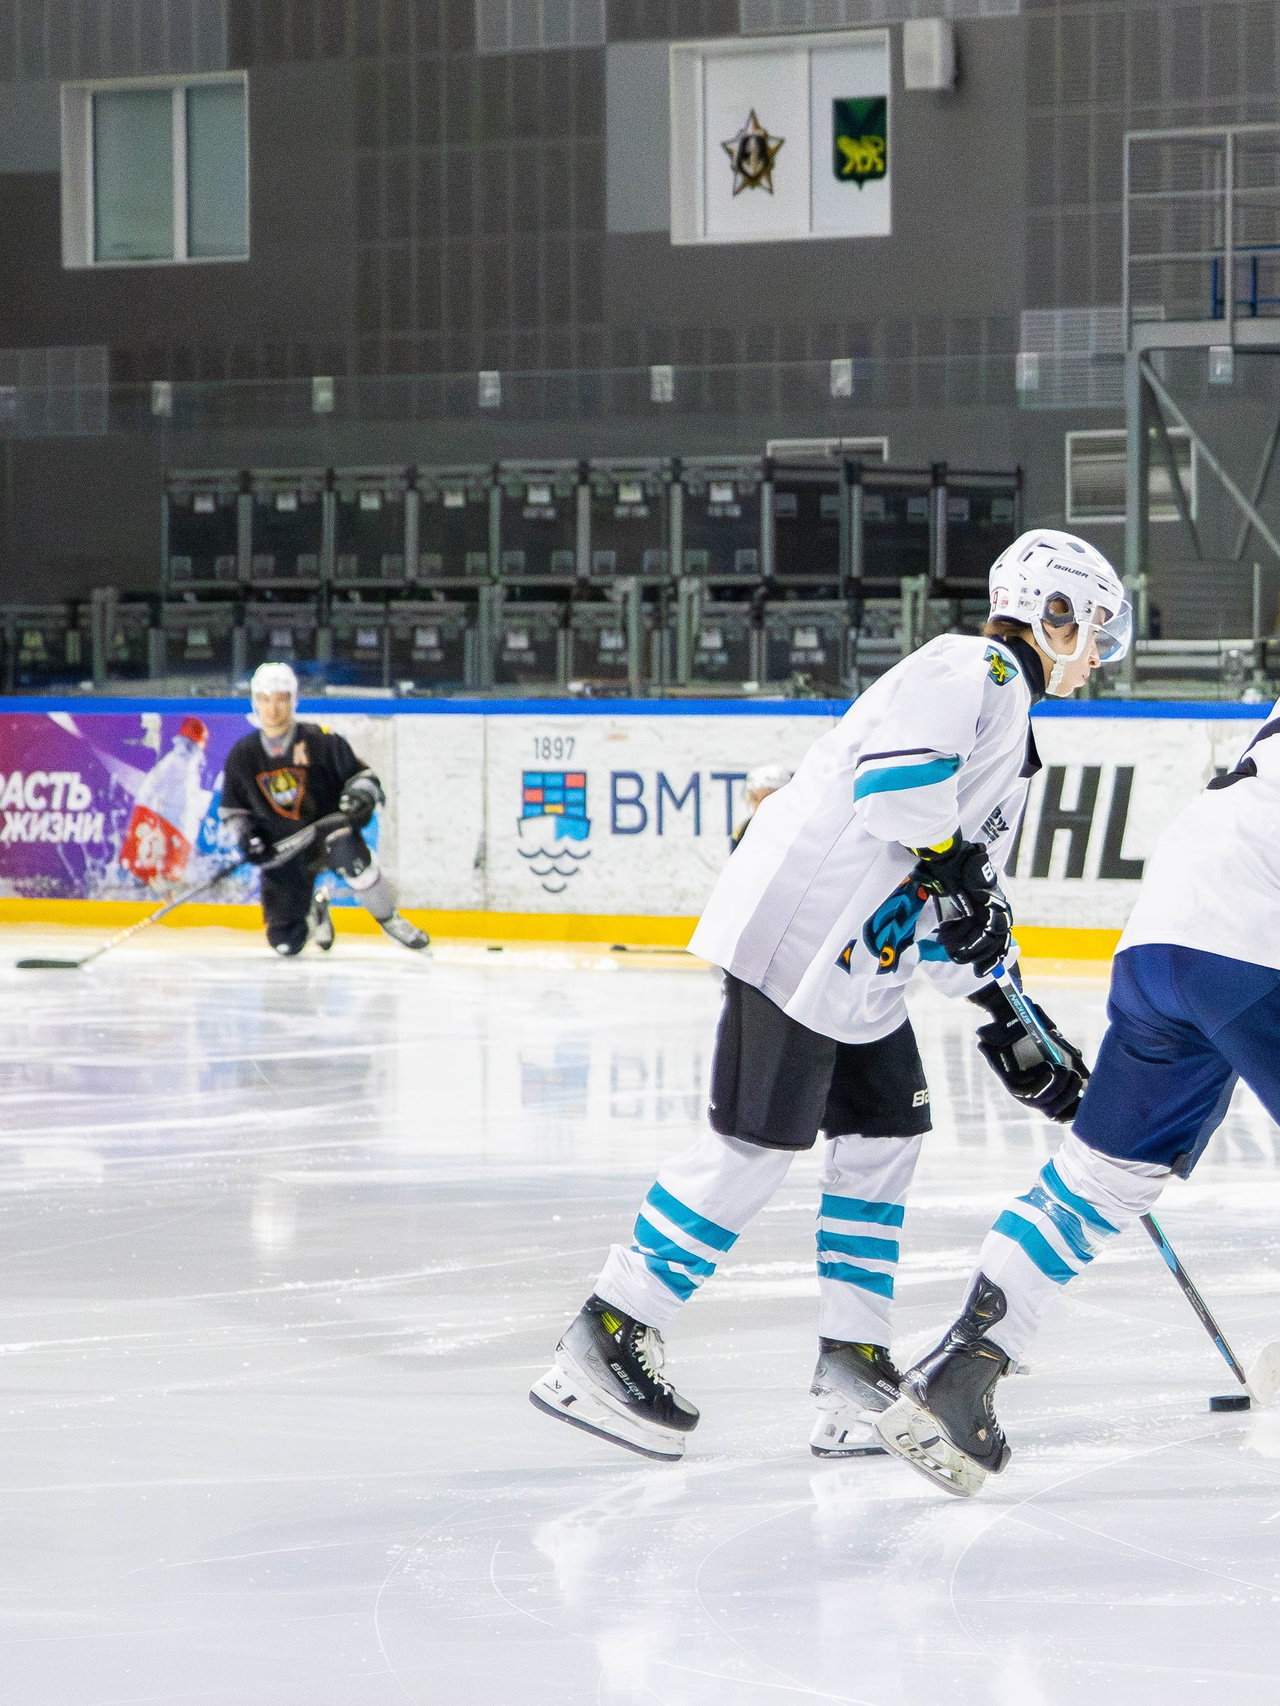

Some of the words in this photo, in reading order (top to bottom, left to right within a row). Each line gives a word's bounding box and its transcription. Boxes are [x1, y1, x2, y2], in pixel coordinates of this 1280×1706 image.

[533, 737, 576, 760] 1897
[610, 771, 748, 836] ВМТ
[610, 1362, 645, 1400] BAUER
